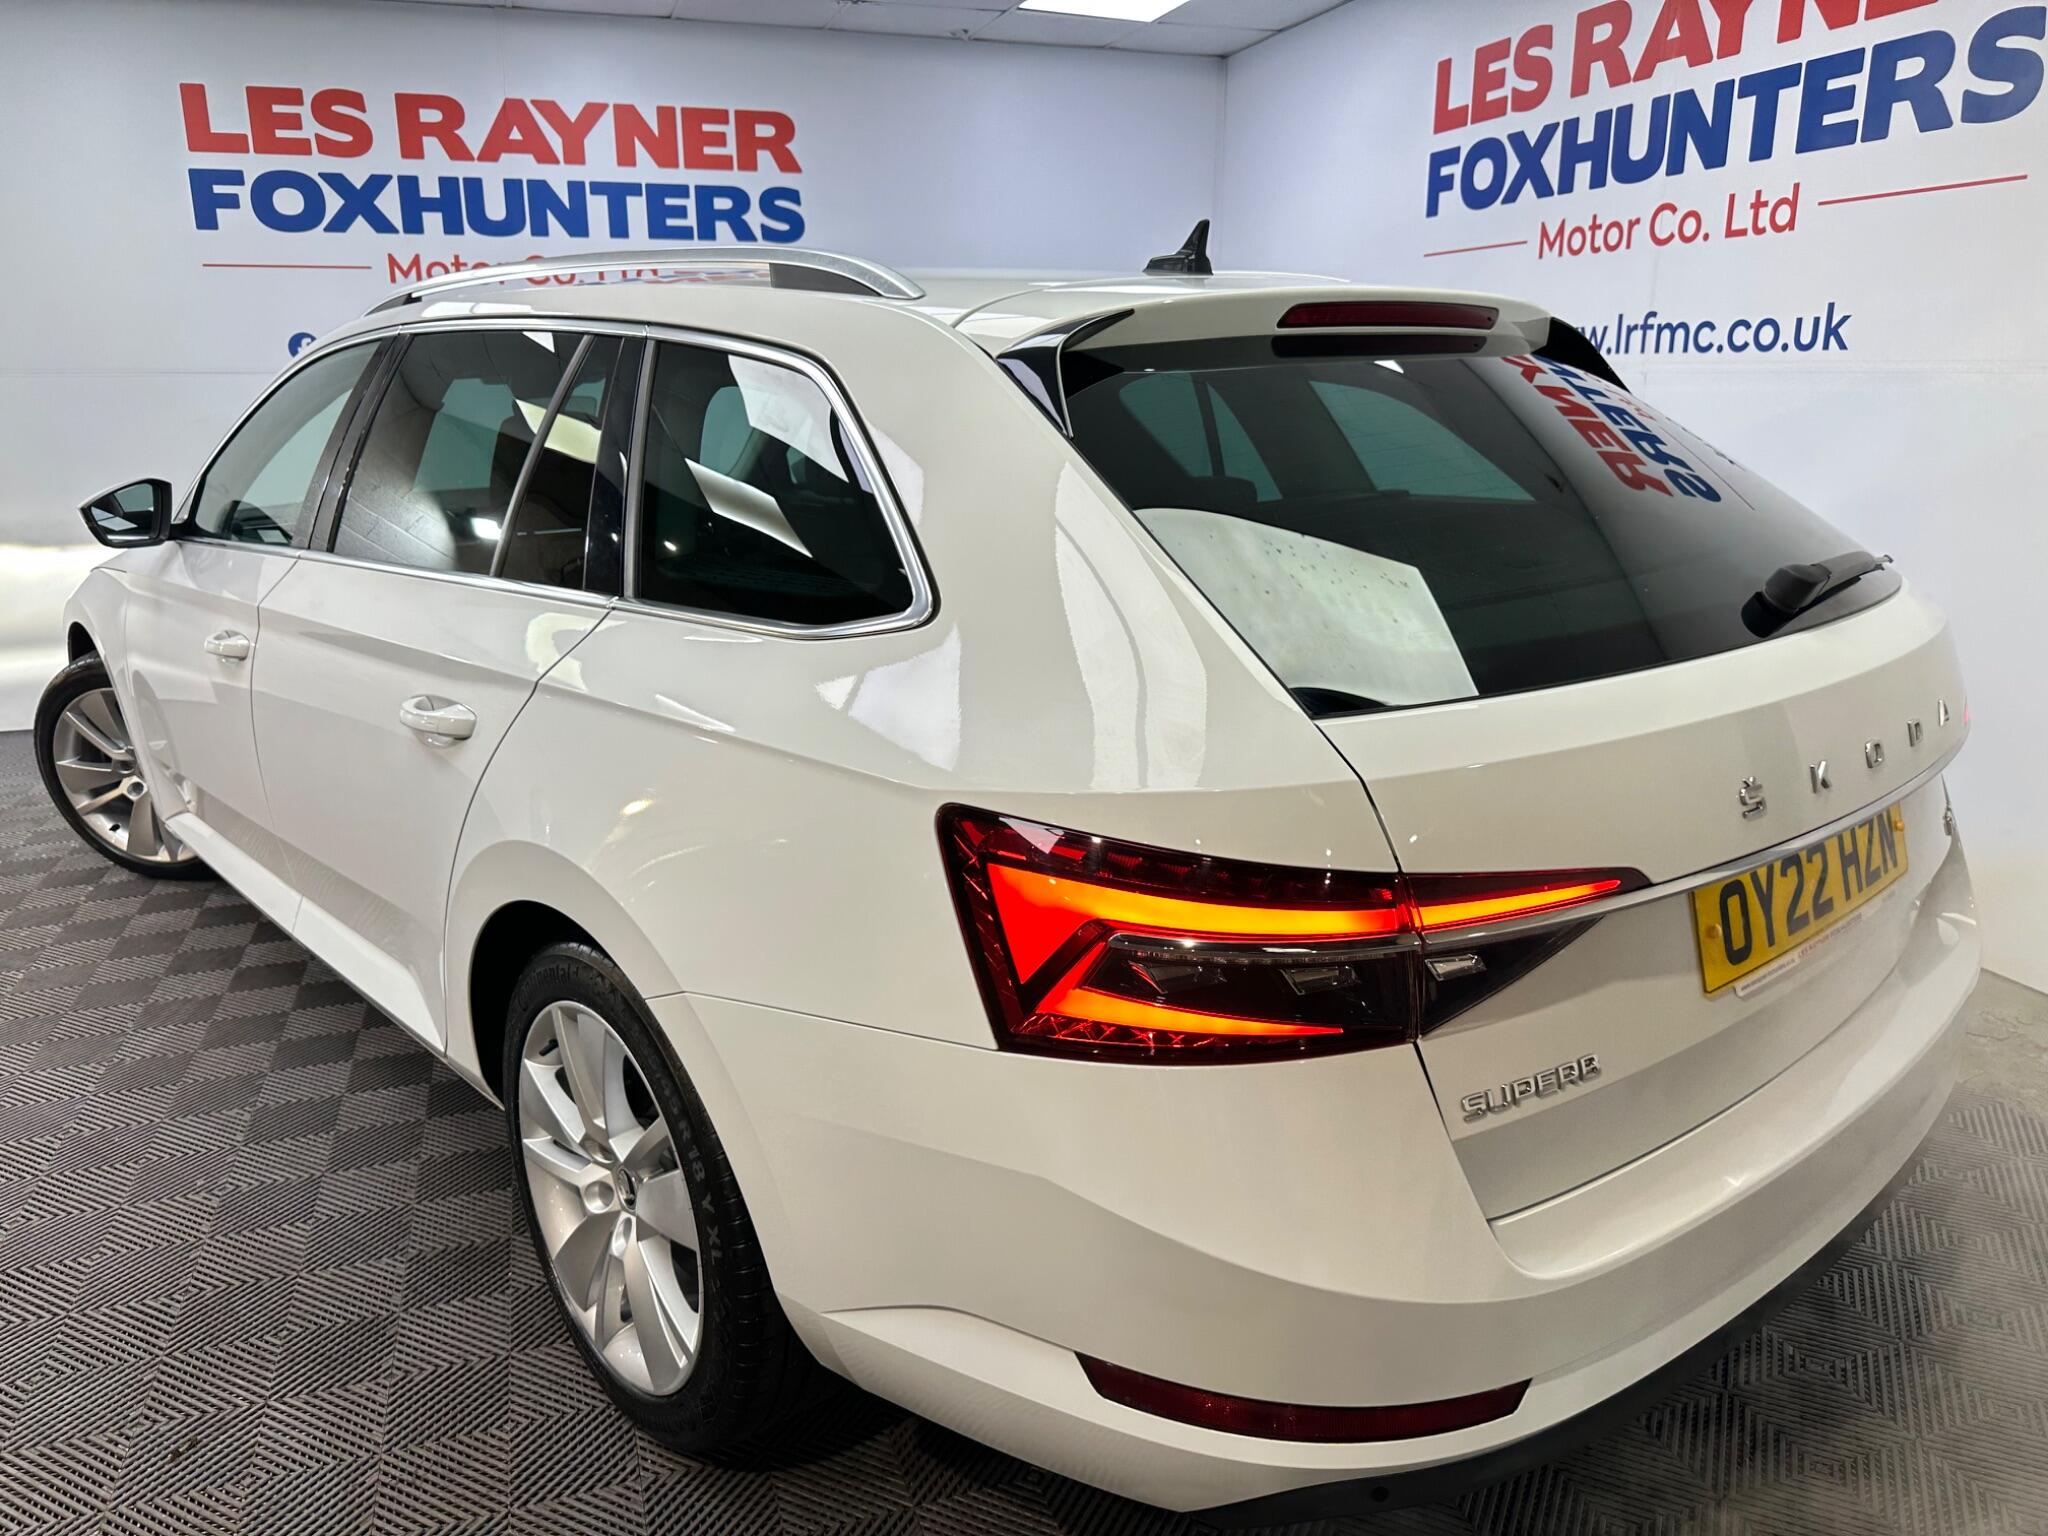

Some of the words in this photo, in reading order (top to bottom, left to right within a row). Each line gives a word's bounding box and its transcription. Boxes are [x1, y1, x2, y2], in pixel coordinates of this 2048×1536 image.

[1425, 6, 2047, 218] FOXHUNTERS
[1433, 26, 1552, 134] LES
[180, 83, 373, 158] LES
[395, 92, 803, 173] RAYNER
[188, 169, 806, 243] FOXHUNTERS
[1538, 218, 1640, 258] Motor
[1649, 203, 1709, 246] Co.
[1724, 183, 1800, 238] Ltd
[1720, 842, 1834, 966] OY22
[1837, 809, 1898, 902] HZN
[1461, 1054, 1602, 1123] SUPERB
